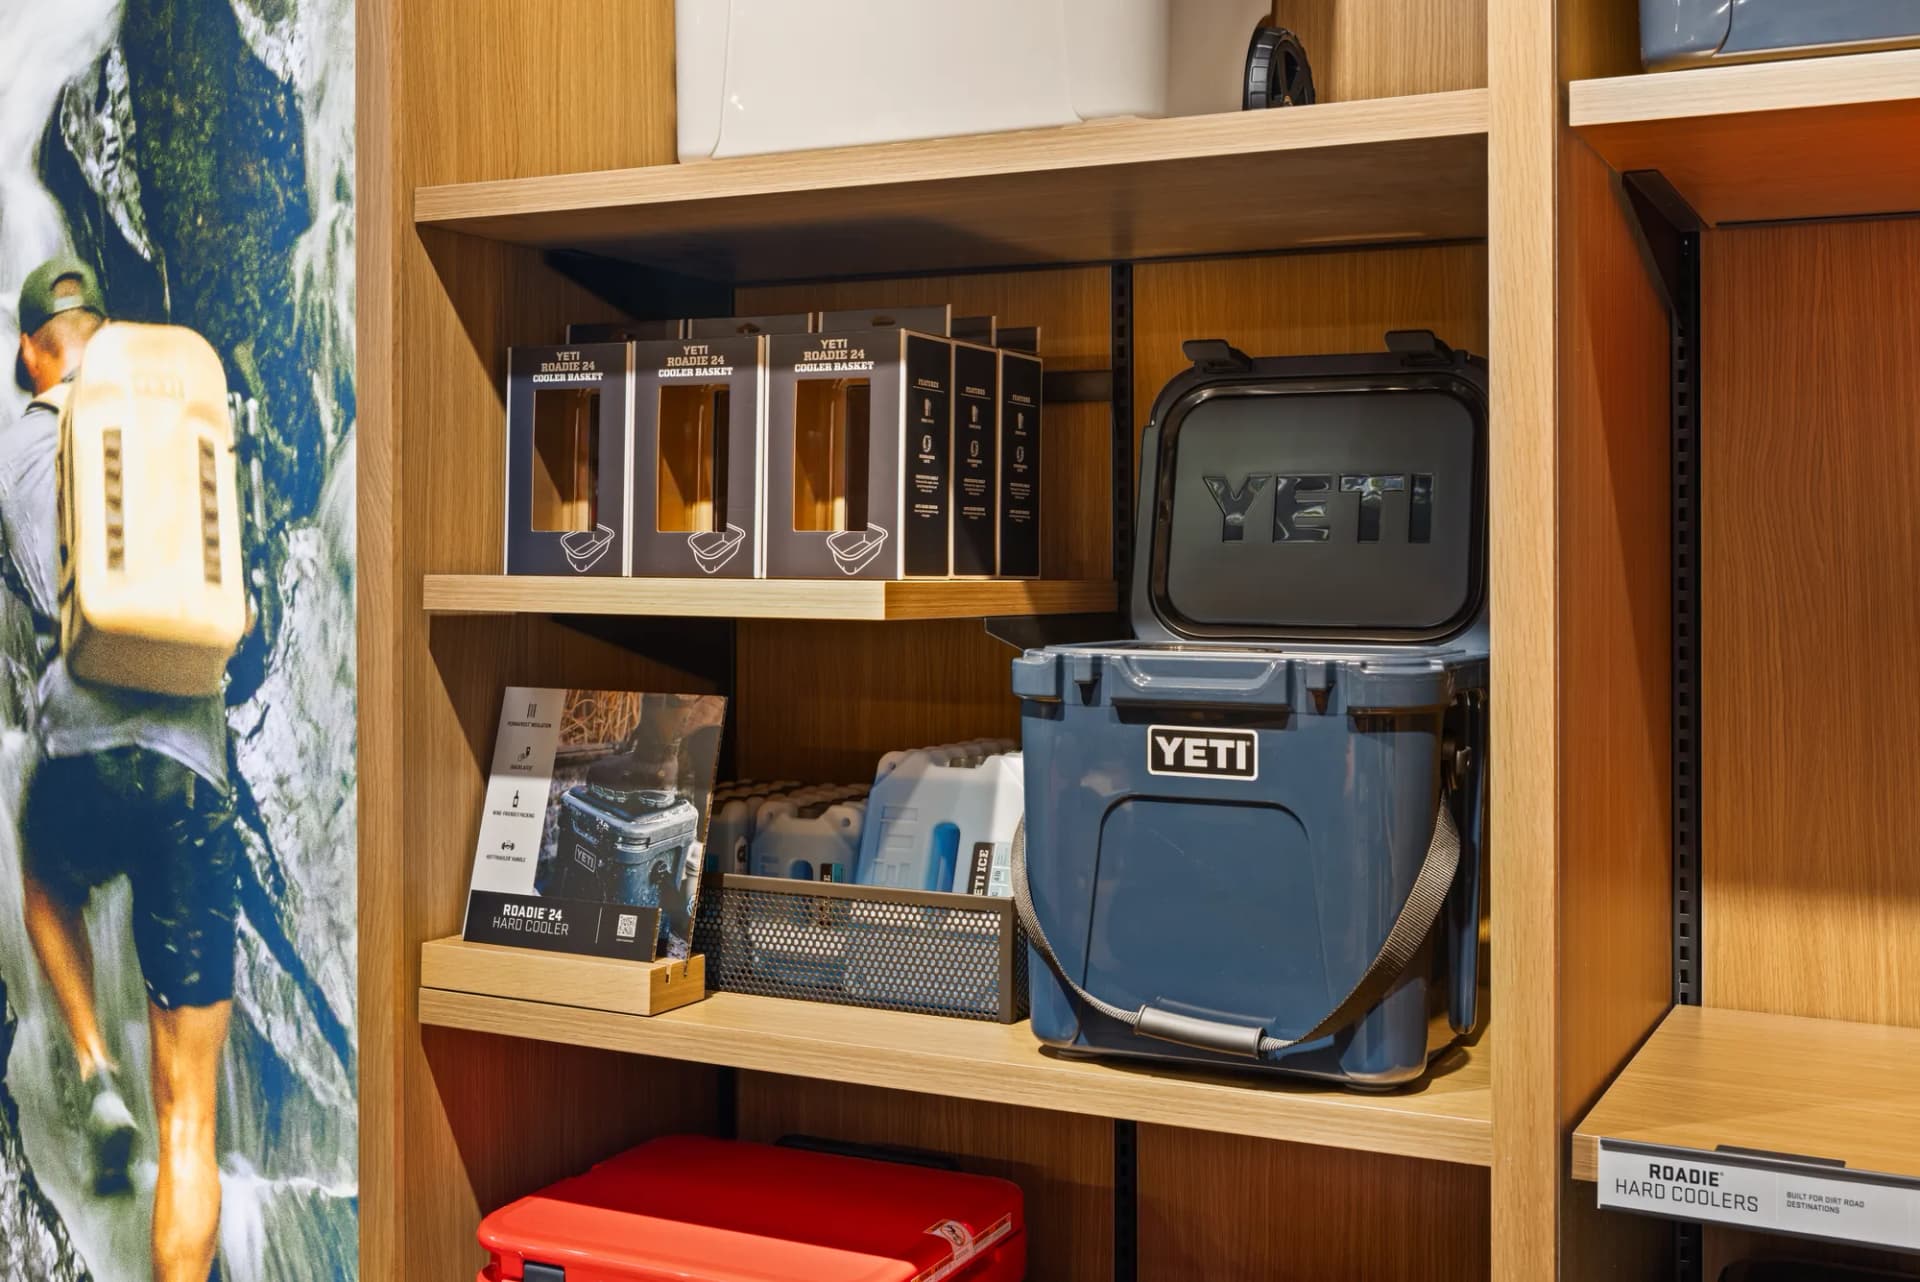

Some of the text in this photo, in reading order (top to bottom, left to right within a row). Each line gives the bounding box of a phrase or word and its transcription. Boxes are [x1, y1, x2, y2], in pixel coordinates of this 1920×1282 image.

[683, 345, 708, 355] YETI
[820, 338, 848, 349] YETI
[556, 351, 580, 361] YETI
[667, 355, 725, 367] ROADIE 24
[804, 349, 865, 361] ROADIE 24
[541, 360, 595, 372] ROADIE 24
[658, 366, 733, 378] COOLER BASKET
[794, 361, 874, 373] COOLER BASKET
[532, 372, 603, 383] COOLER BASKET
[1202, 474, 1433, 544] YETI
[1155, 736, 1247, 770] YETI
[576, 847, 594, 869] YETI
[974, 849, 989, 896] ETI ICE
[503, 903, 562, 922] ROADIE 24
[492, 916, 569, 936] HARD COOLER
[1649, 1163, 1719, 1187] ROADIE
[1616, 1178, 1759, 1212] HARD COOLERS
[1786, 1191, 1865, 1208] BUILT FOR DIRT ROAD
[1786, 1200, 1840, 1214] DESTINATIONS
